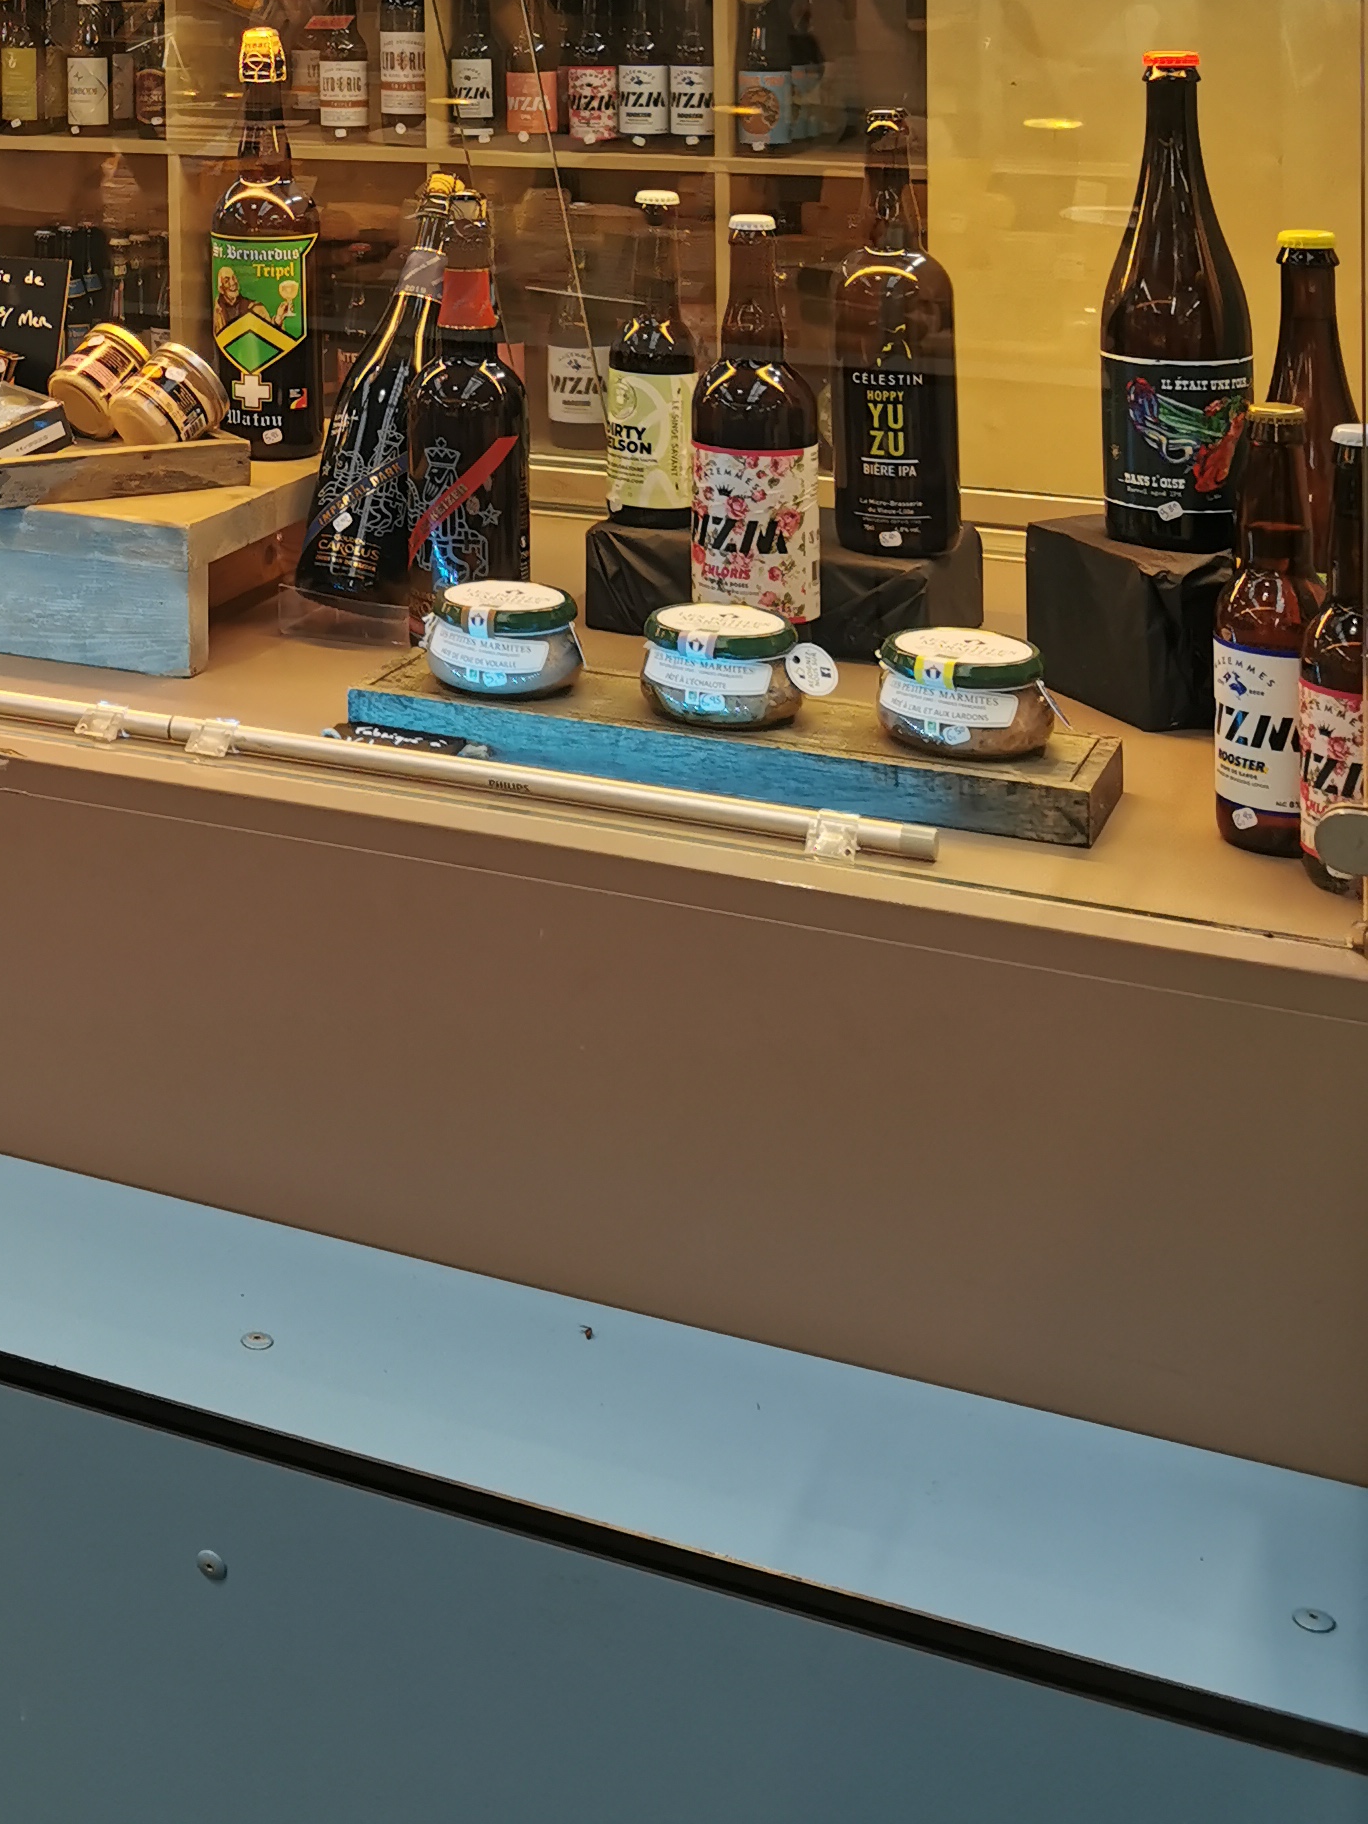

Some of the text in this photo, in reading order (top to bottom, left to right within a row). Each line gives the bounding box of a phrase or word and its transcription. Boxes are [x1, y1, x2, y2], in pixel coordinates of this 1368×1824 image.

[227, 243, 300, 262] Bernardus
[24, 270, 45, 287] de
[253, 261, 295, 281] Tripel
[18, 310, 53, 330] Mer
[852, 371, 923, 386] CÉLESTIN
[1161, 376, 1230, 391] IL ÉTAIT UNE
[866, 389, 904, 402] HOPPY
[867, 402, 904, 430] YU
[671, 413, 680, 439] SINGE
[607, 437, 652, 456] ELSON
[869, 430, 905, 457] ZU
[670, 441, 680, 477] SAVANT
[863, 462, 918, 477] BIÈRE IPA
[1151, 474, 1185, 489] L'OISE
[318, 484, 370, 526] IMPERIAL
[318, 538, 381, 561] CAROLUS
[480, 640, 532, 654] MARMITES
[700, 661, 754, 675] MARMITES
[902, 681, 935, 697] PETITES
[938, 691, 999, 707] MARMITES
[934, 707, 950, 718] AUX
[952, 710, 990, 723] LARDONS
[1218, 747, 1267, 773] ROOSTER
[488, 778, 531, 793] PHILIPS
